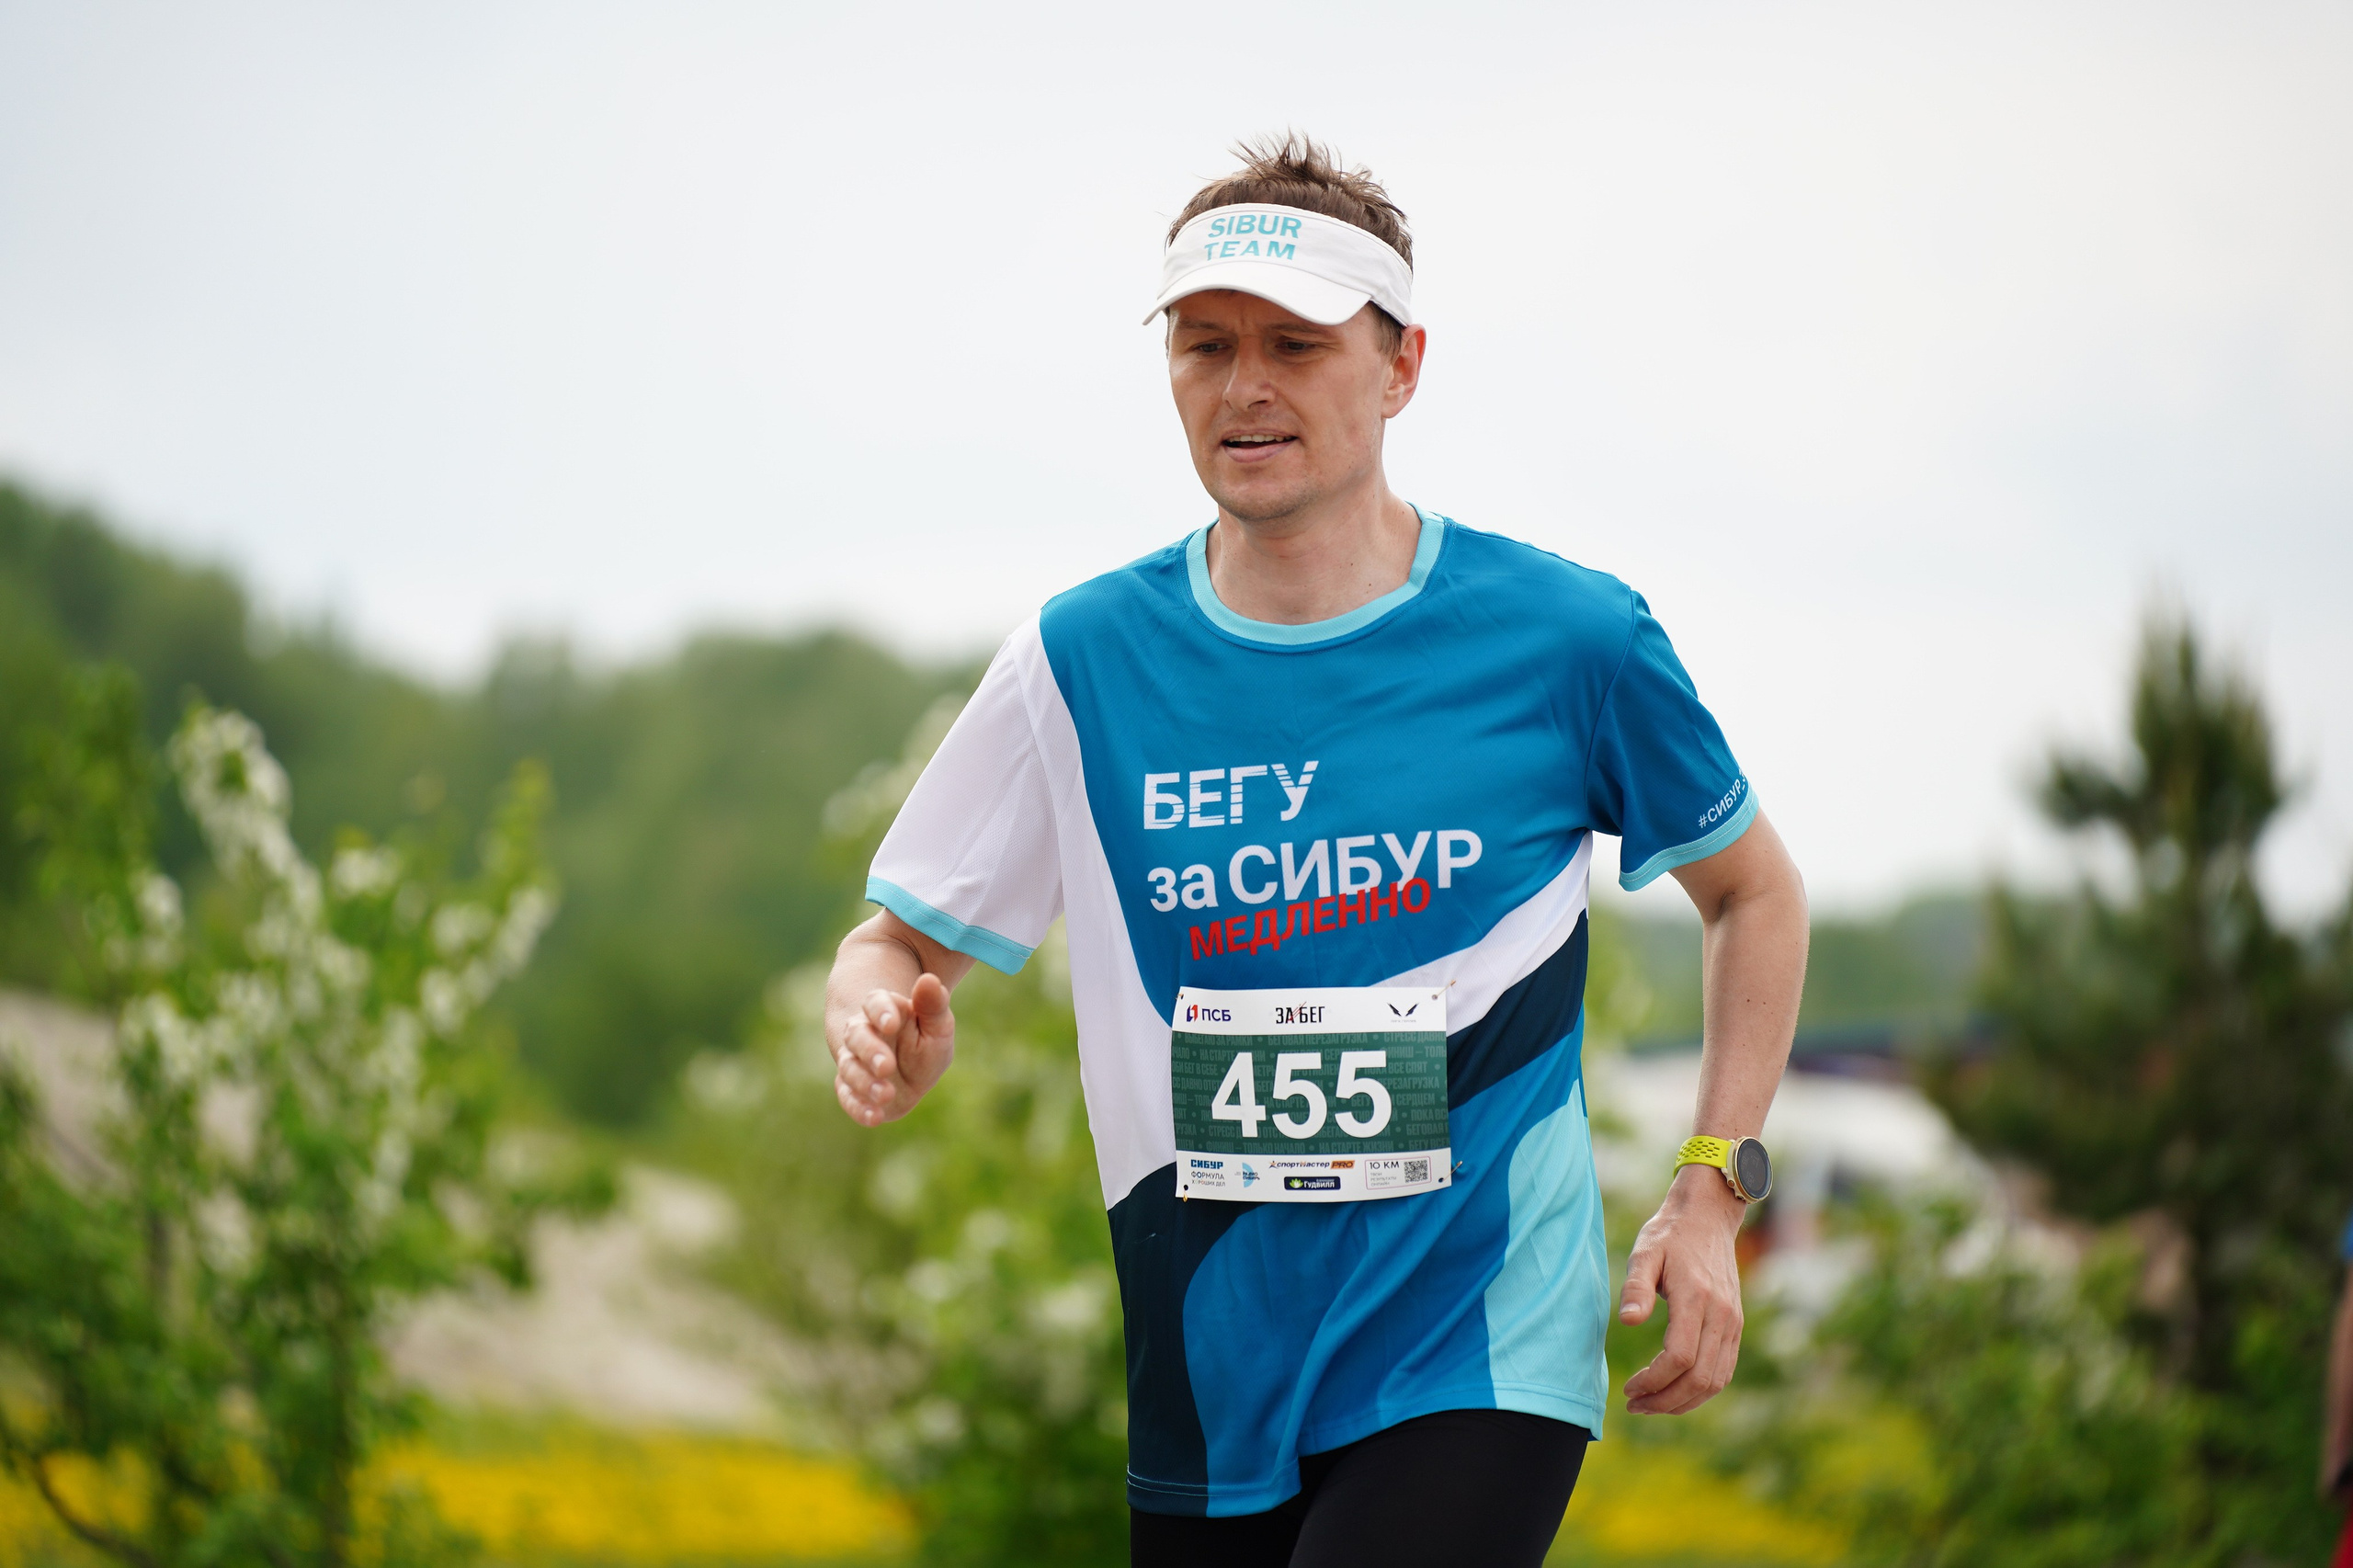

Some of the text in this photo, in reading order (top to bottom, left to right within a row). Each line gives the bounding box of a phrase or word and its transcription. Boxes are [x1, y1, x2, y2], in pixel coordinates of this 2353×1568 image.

[1207, 213, 1302, 239] SIBUR
[1204, 240, 1296, 261] TEAM
[1142, 760, 1320, 830] БЕГУ
[1146, 829, 1483, 913] за СИБУР
[1188, 877, 1432, 961] МЕДЛЕННО
[1201, 1008, 1232, 1022] ПСБ
[1211, 1050, 1392, 1140] 455
[1190, 1159, 1223, 1169] СИБУР
[1190, 1171, 1224, 1180] ФОРМУЛА
[1303, 1180, 1335, 1188] Гудвилл
